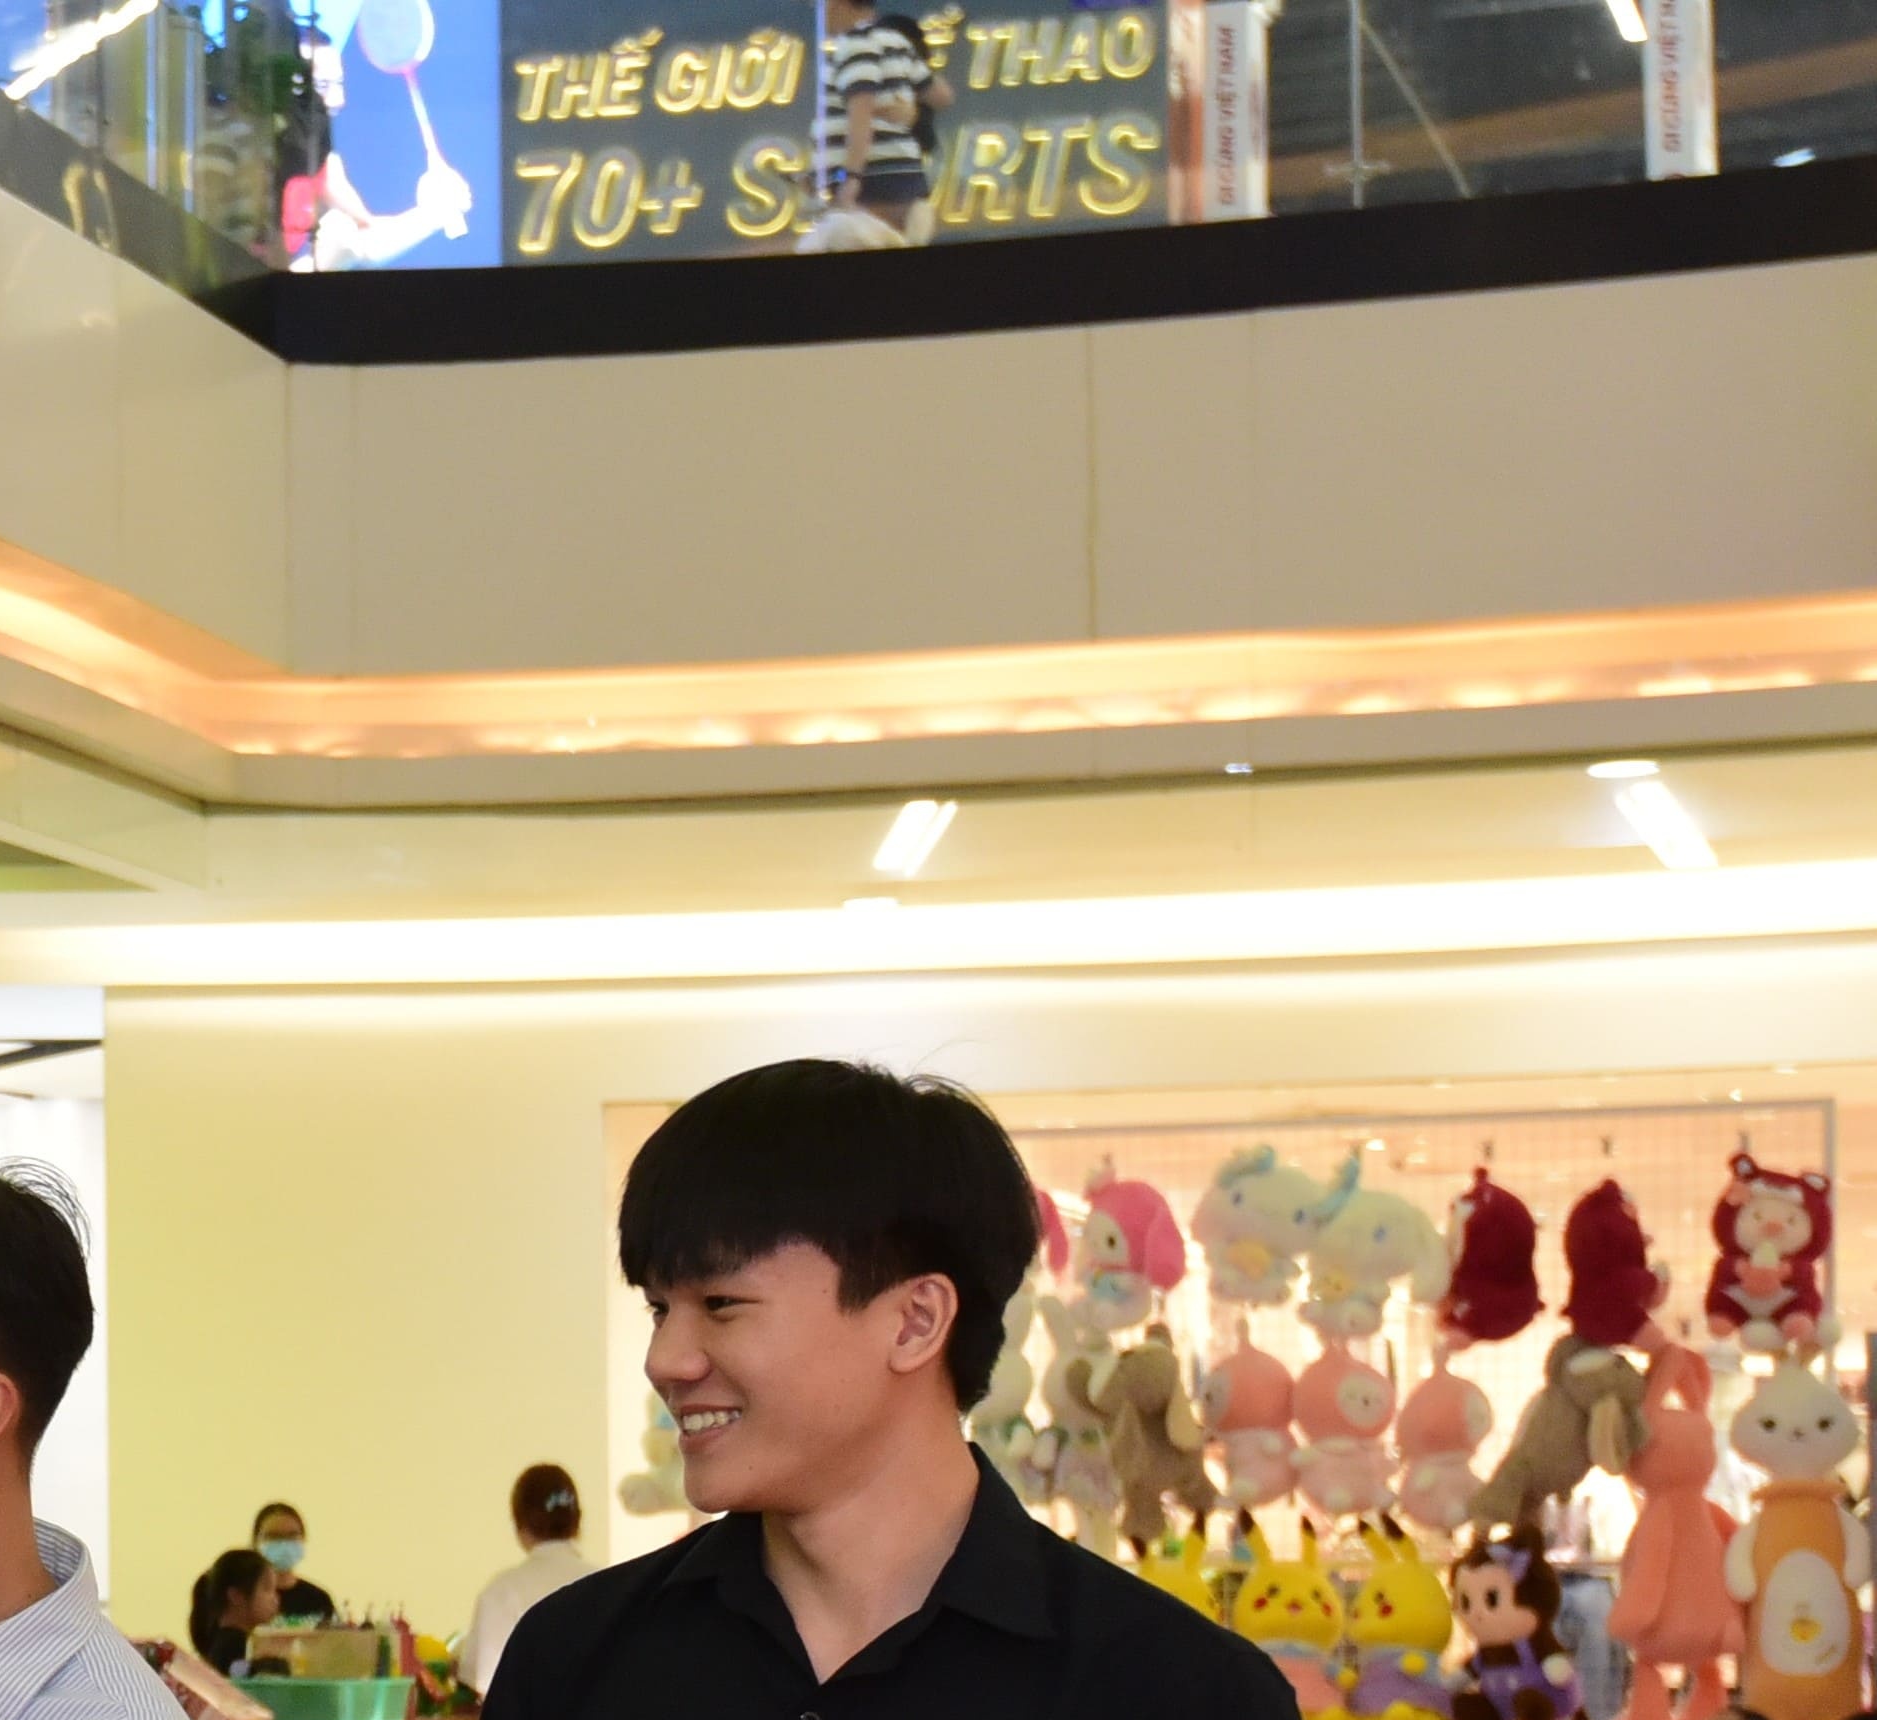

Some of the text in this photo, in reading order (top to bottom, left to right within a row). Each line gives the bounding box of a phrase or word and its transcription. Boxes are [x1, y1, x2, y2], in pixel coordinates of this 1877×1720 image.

[514, 27, 663, 121] THẾ
[655, 29, 805, 112] GIỚI
[966, 11, 1158, 89] THAO
[515, 109, 1163, 254] 70+ SRTS
